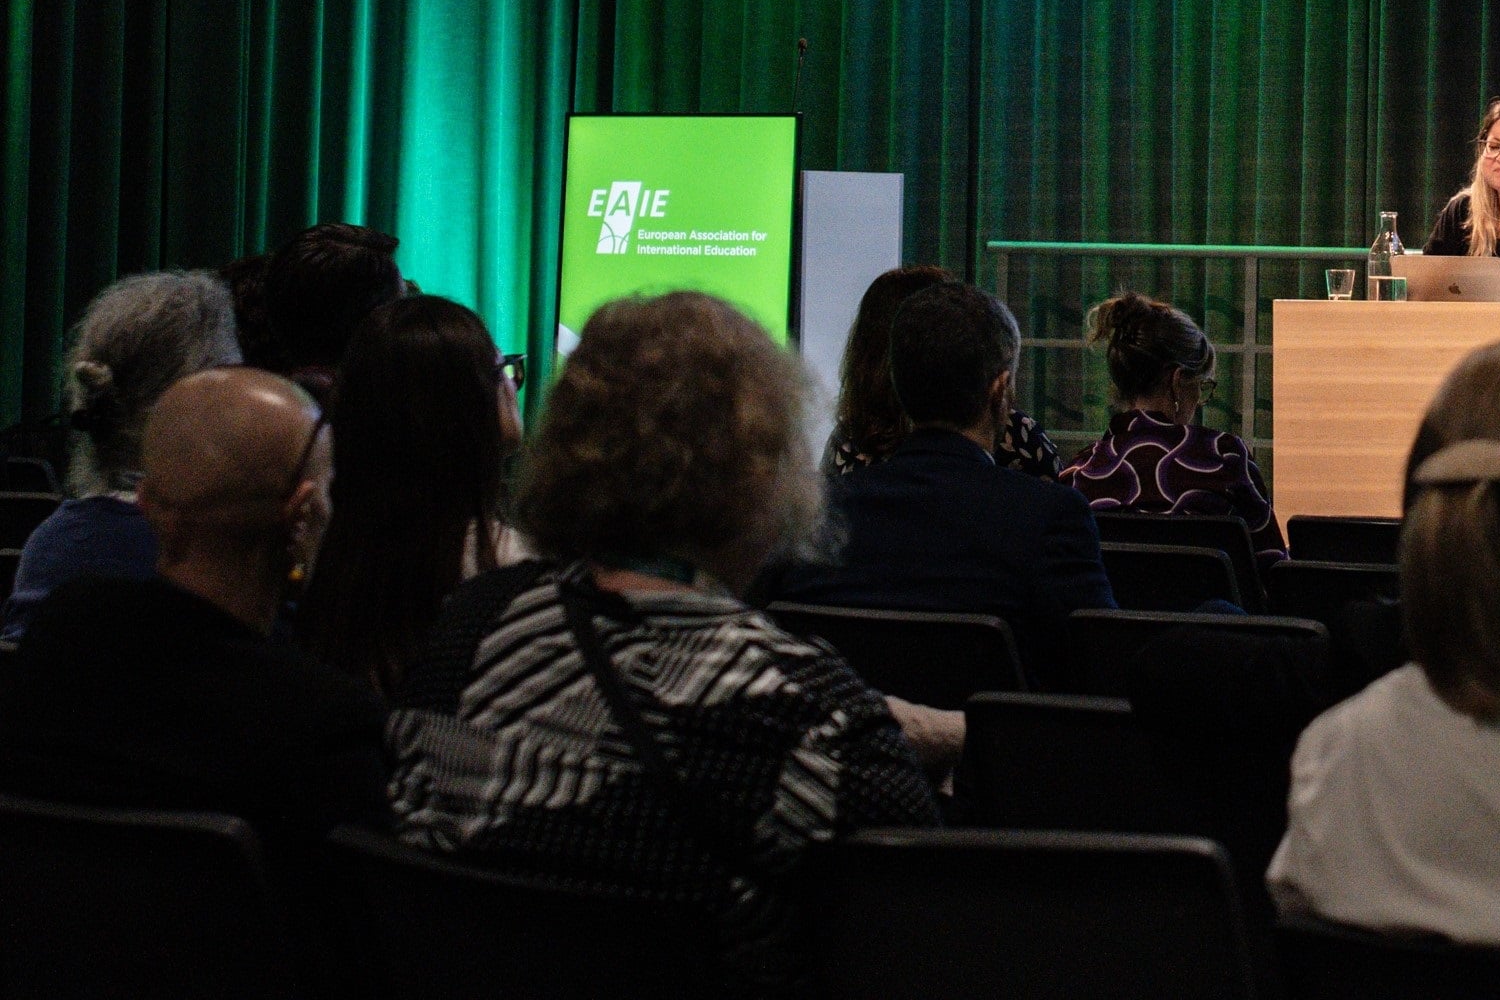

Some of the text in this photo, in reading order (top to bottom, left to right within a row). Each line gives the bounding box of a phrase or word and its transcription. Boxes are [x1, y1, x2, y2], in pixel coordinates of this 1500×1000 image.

[586, 188, 671, 218] EAIE
[637, 229, 768, 242] European Association for
[636, 243, 757, 257] International Education
